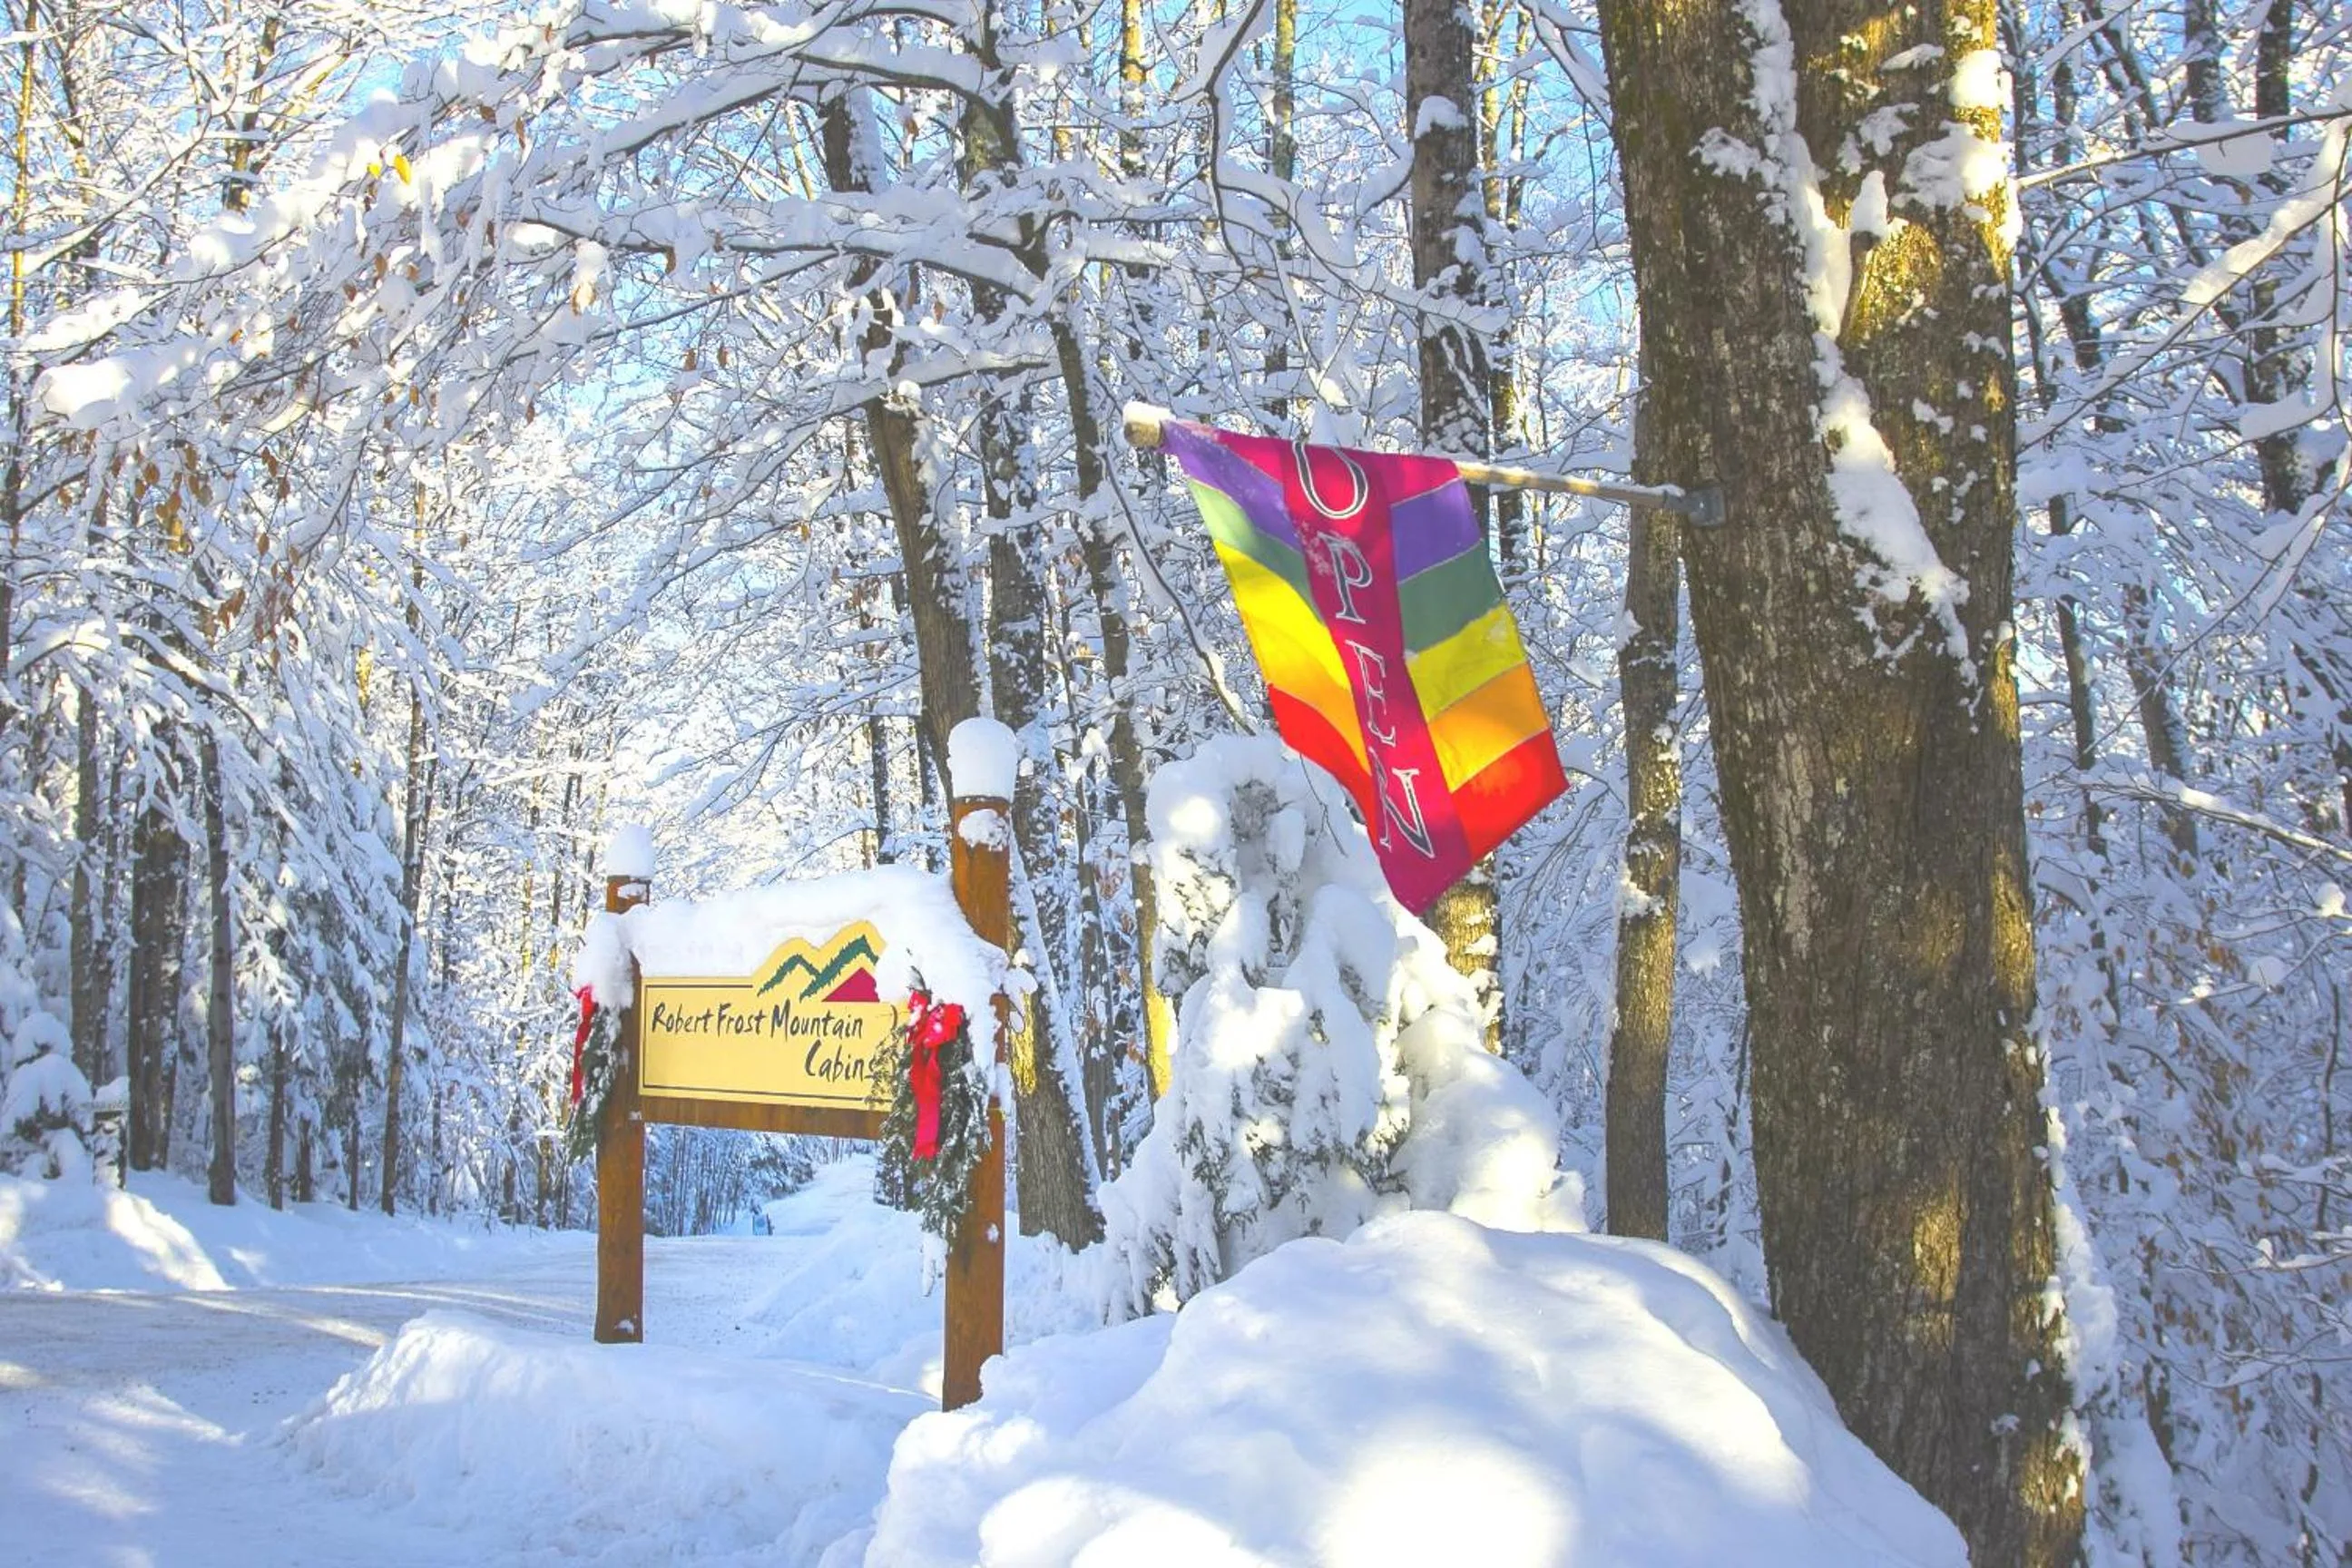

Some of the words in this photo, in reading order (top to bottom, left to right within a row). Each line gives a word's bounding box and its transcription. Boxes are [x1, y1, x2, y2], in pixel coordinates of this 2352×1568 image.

[1292, 439, 1436, 858] OPEN
[652, 1001, 714, 1034] Robert
[717, 1002, 767, 1038] Frost
[770, 997, 863, 1043] Mountain
